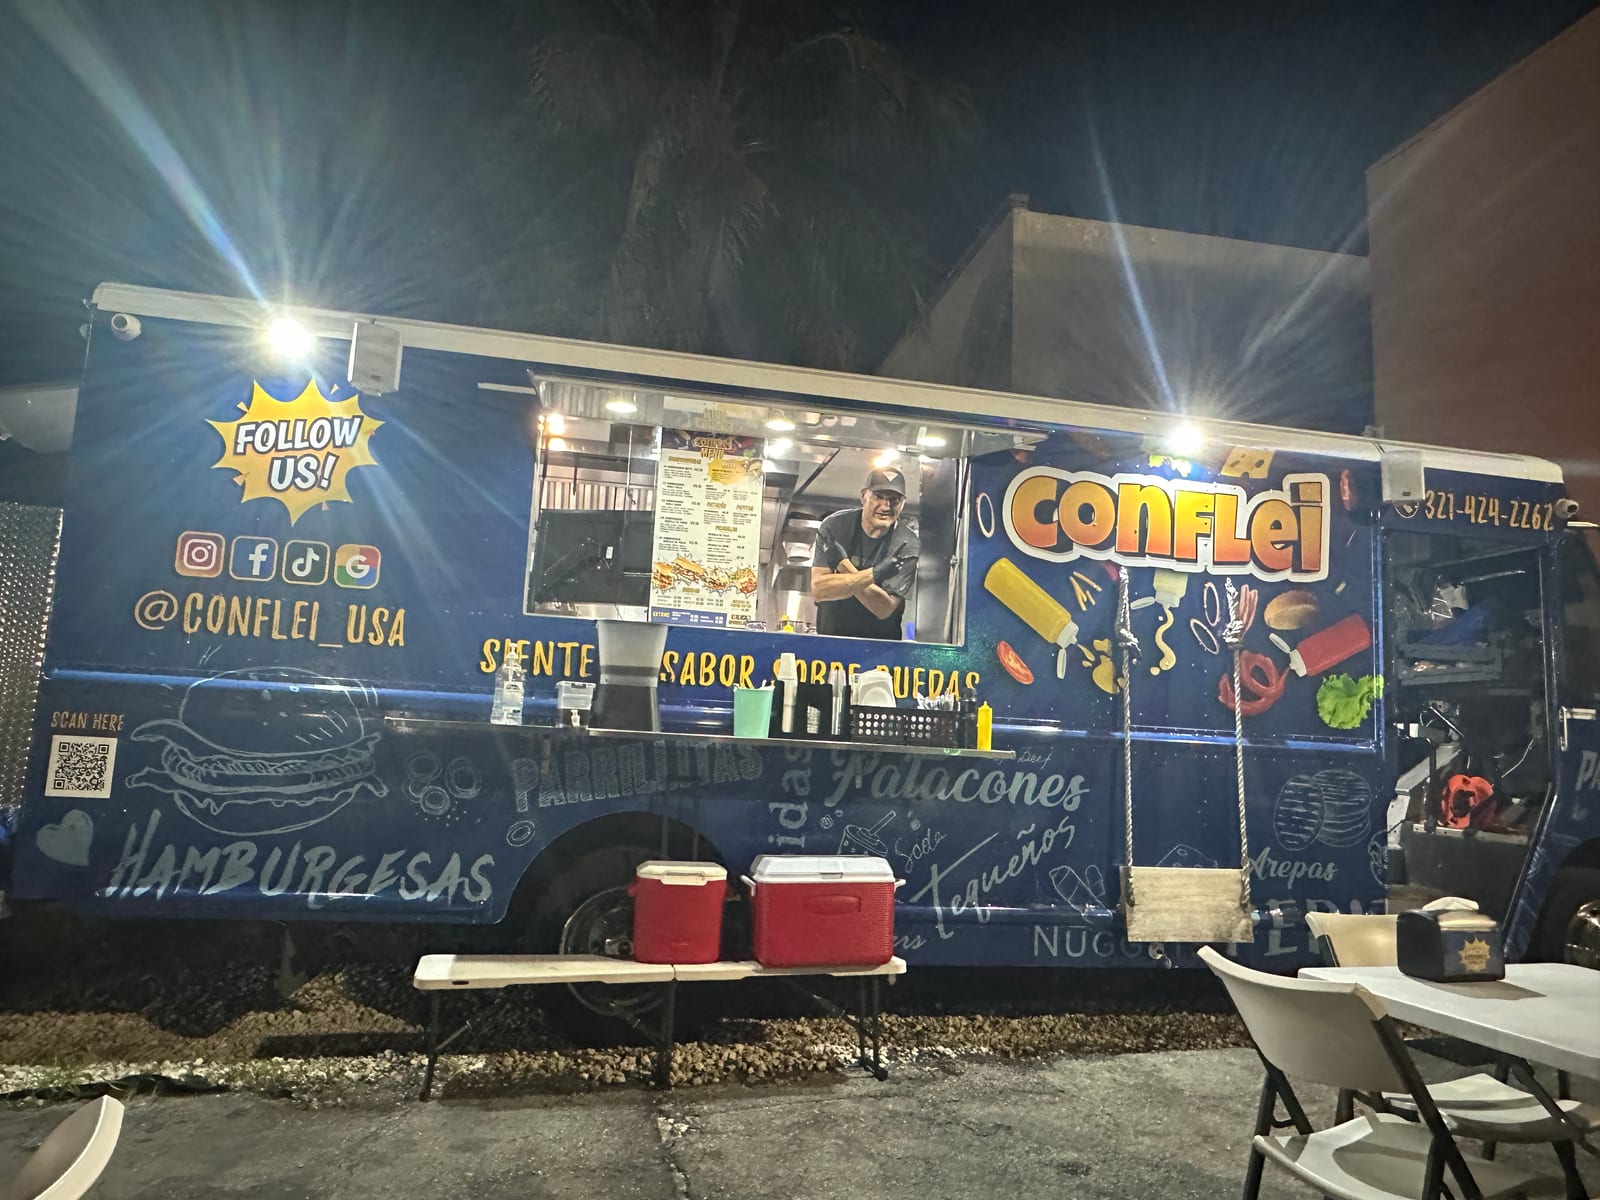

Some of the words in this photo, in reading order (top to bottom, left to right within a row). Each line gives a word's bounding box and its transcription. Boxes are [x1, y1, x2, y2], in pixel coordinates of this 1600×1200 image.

[236, 415, 363, 455] FOLLOW
[269, 452, 337, 492] US!
[1425, 490, 1554, 531] 321-424-2262
[134, 590, 406, 648] @CONFLEI_USA
[650, 650, 756, 689] SABOR
[876, 664, 980, 700] UEDAS
[50, 711, 88, 729] SCAN
[93, 713, 125, 731] HERE
[824, 748, 1089, 812] Patacones
[103, 808, 496, 908] HAMBURGESAS
[910, 816, 1075, 939] Tequeños
[1248, 847, 1339, 890] Arepas
[1033, 924, 1182, 958] NUGG
